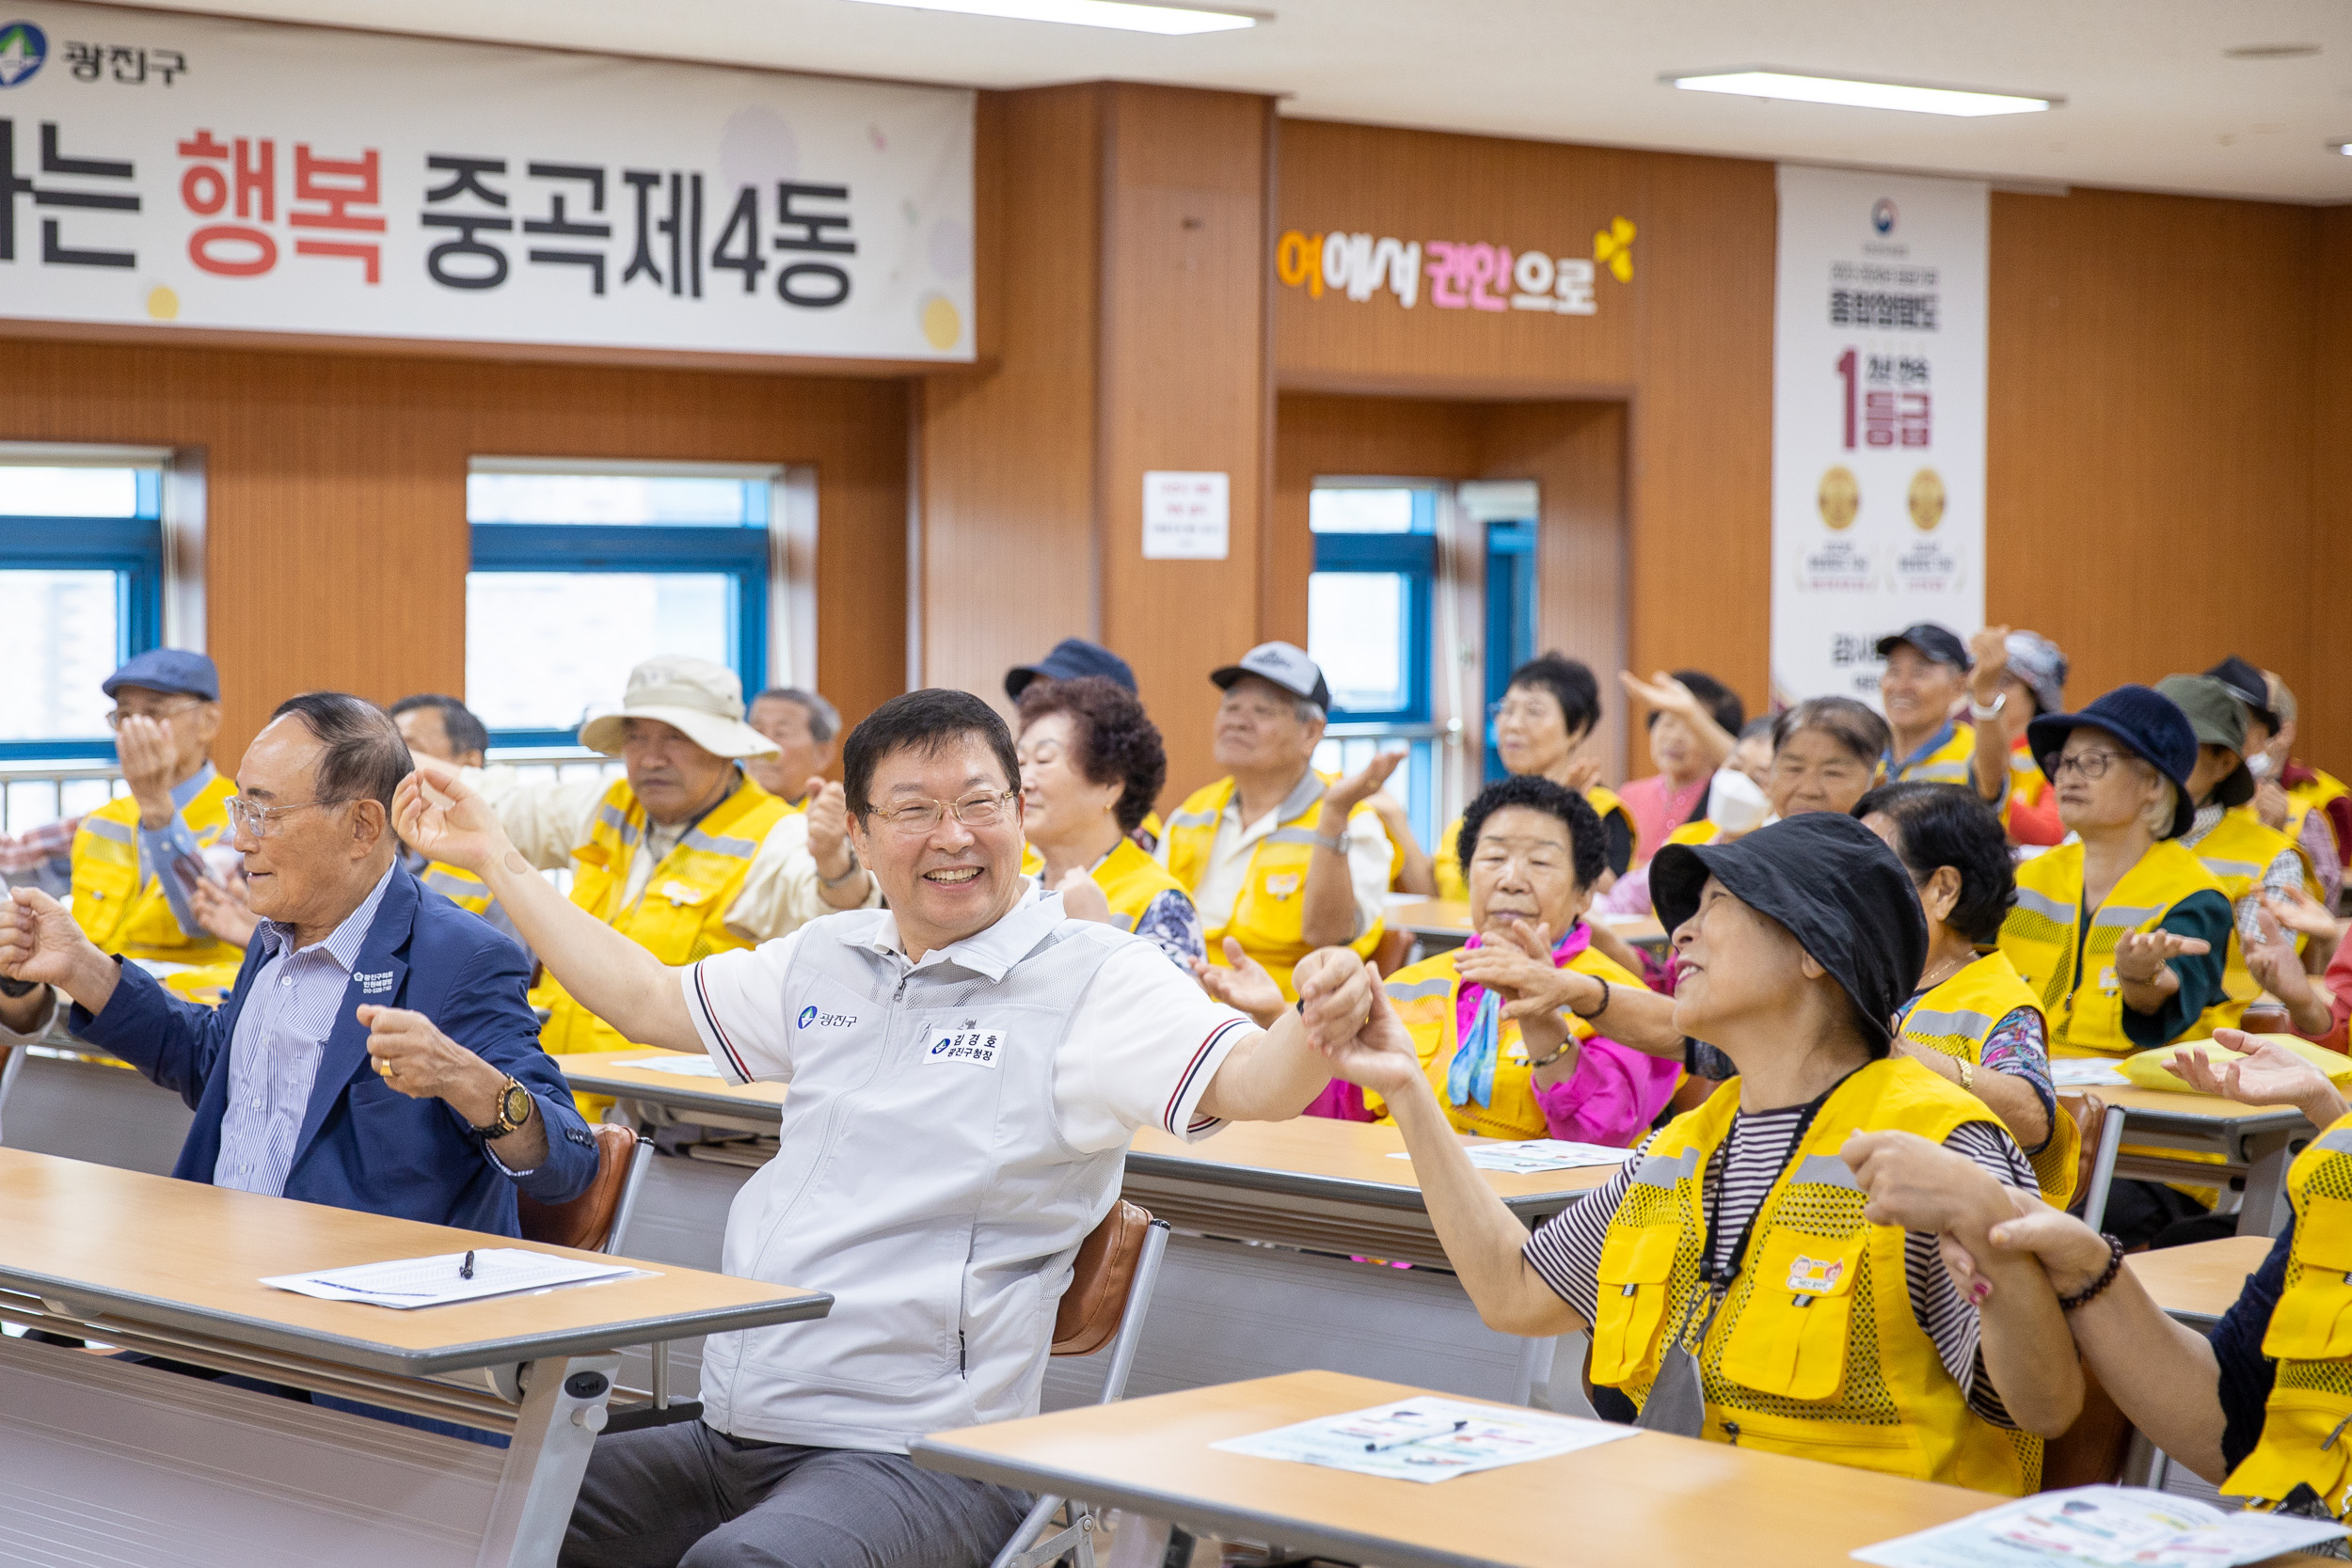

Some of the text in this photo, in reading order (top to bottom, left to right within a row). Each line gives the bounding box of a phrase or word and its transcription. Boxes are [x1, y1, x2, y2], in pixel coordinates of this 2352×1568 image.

[62, 39, 187, 88] 광진구
[176, 127, 388, 286] 행복
[420, 152, 858, 312] 중곡제4동
[819, 1012, 857, 1028] 광진구
[953, 1034, 997, 1049] 김경호
[947, 1047, 993, 1062] 광진구청장
